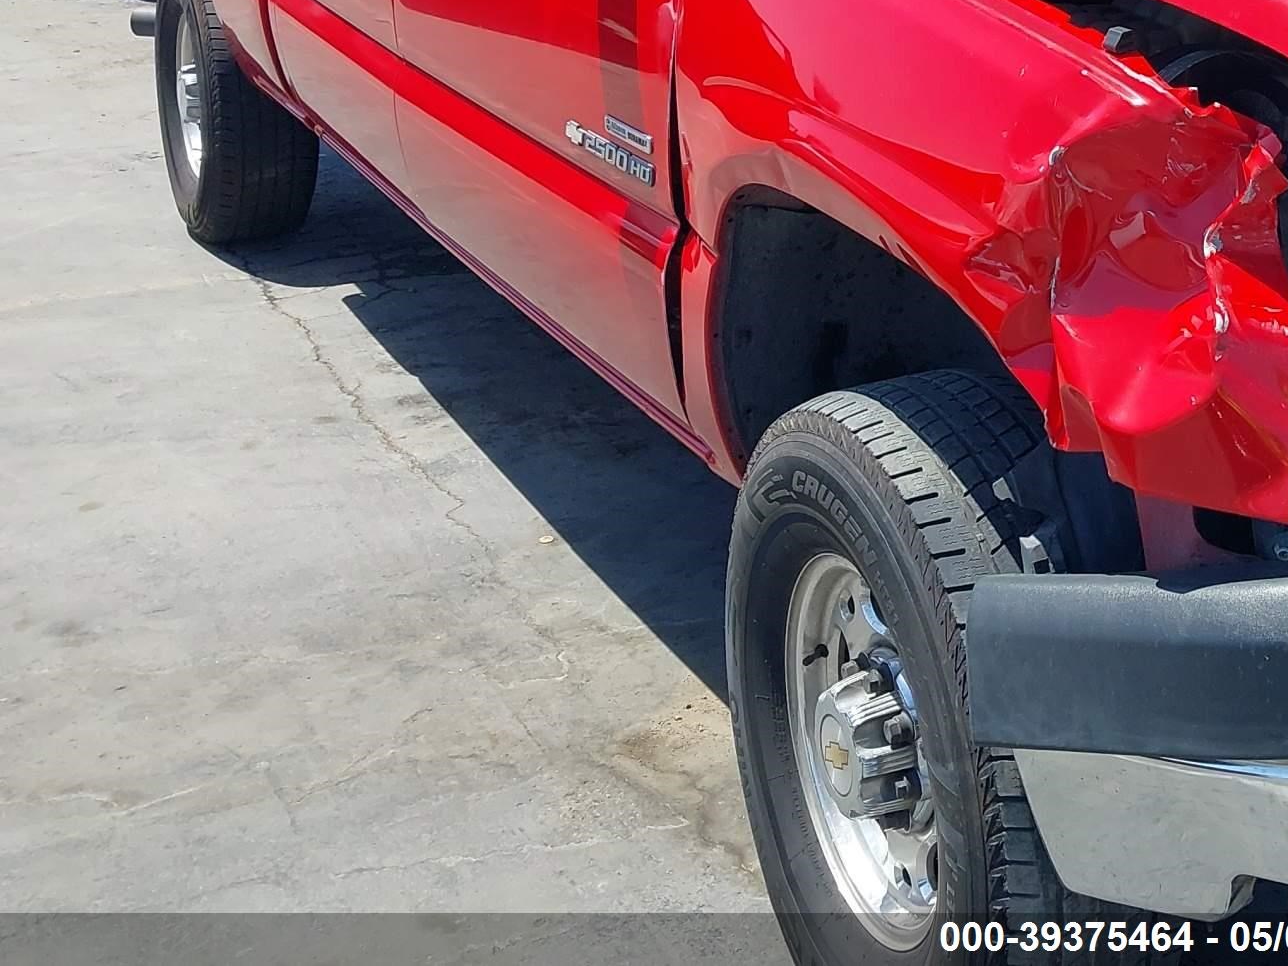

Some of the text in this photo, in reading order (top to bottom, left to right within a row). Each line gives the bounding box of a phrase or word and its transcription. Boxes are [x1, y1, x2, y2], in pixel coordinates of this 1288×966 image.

[584, 135, 651, 184] 2500 HD
[792, 470, 878, 567] CRUGEN
